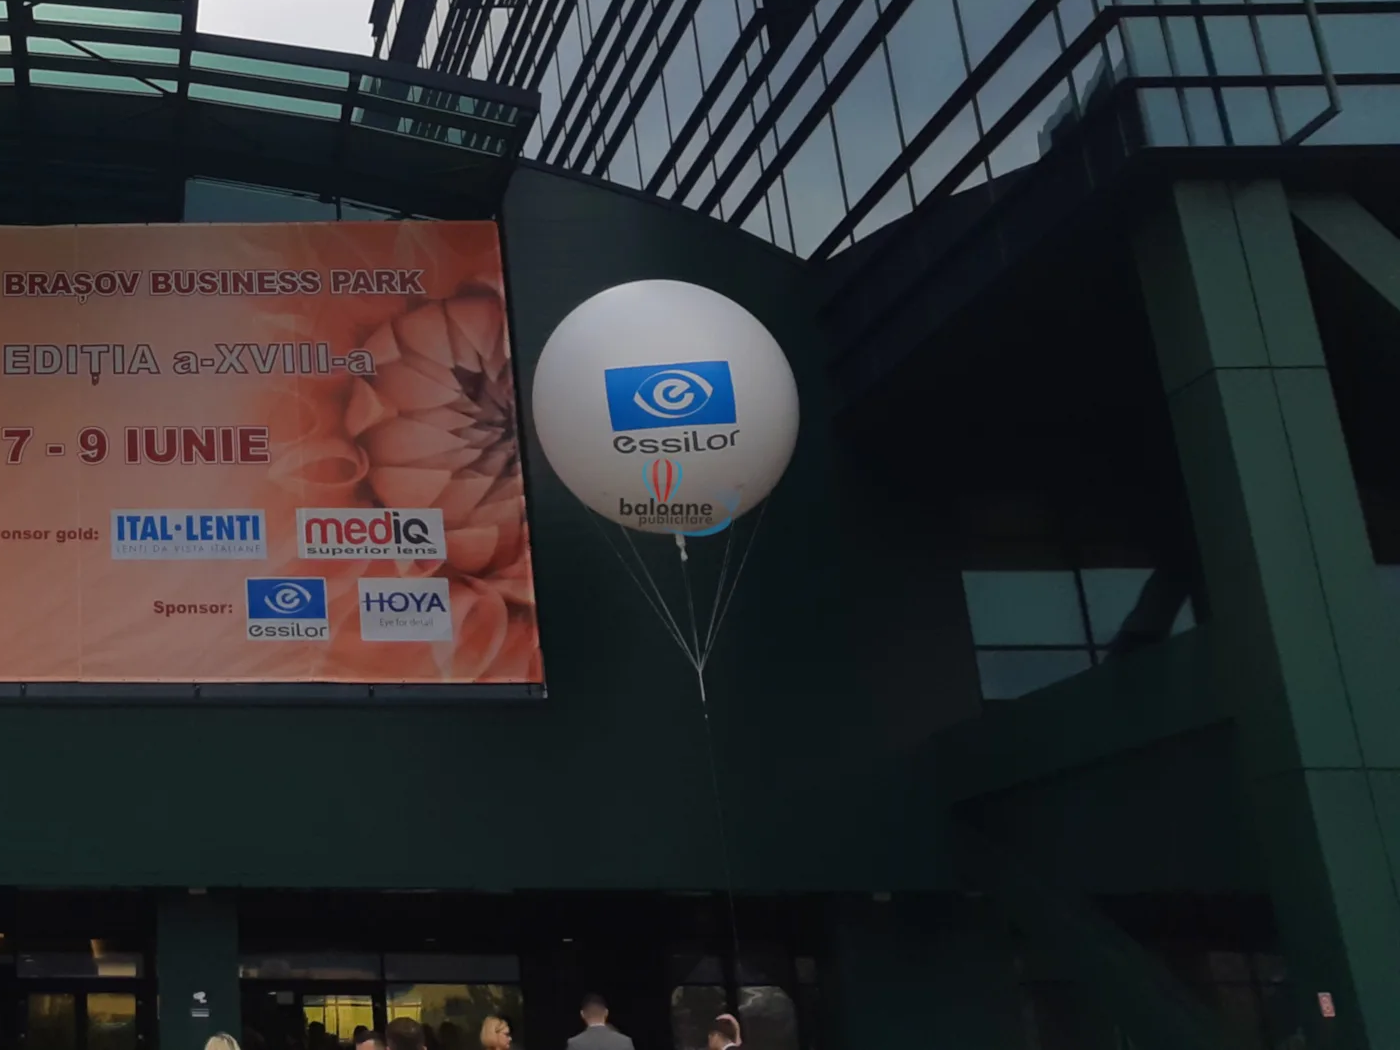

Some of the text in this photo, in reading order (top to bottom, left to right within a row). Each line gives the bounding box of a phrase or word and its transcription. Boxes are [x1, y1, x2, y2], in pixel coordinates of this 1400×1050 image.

[149, 269, 322, 296] BUSINESS
[330, 269, 427, 296] PARK
[172, 341, 377, 376] a-XVIII-a
[124, 426, 272, 465] IUNIE
[56, 526, 99, 543] gold:
[305, 511, 434, 545] mediQ
[307, 545, 438, 556] superior lens
[153, 601, 233, 617] Sponsor:
[362, 592, 447, 613] HOYA
[248, 622, 328, 638] essilor
